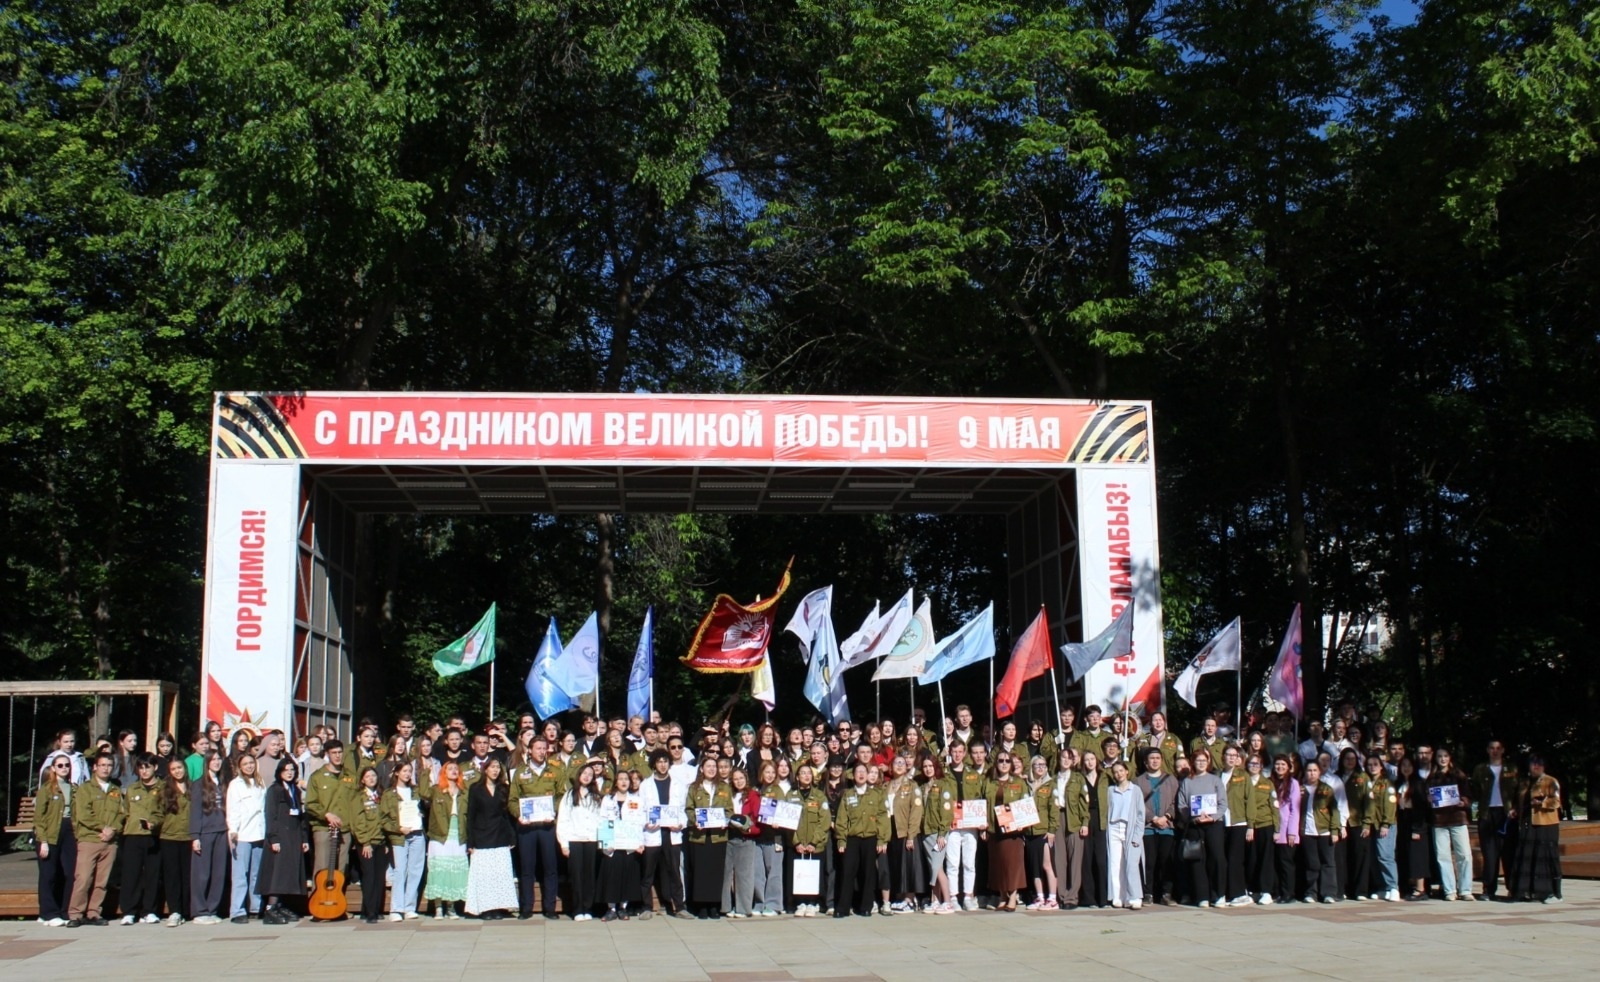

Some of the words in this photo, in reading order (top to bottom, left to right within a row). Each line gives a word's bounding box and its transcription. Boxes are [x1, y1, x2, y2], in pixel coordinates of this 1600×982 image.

[314, 410, 337, 445] С
[348, 411, 592, 451] ПРАЗДНИКОМ
[603, 409, 764, 448] ВЕЛИКОЙ
[774, 412, 929, 453] ПОБЕДЫ!
[958, 417, 978, 447] 9
[988, 416, 1061, 449] МАЯ
[236, 510, 267, 651] ГОРДИМСЯ!
